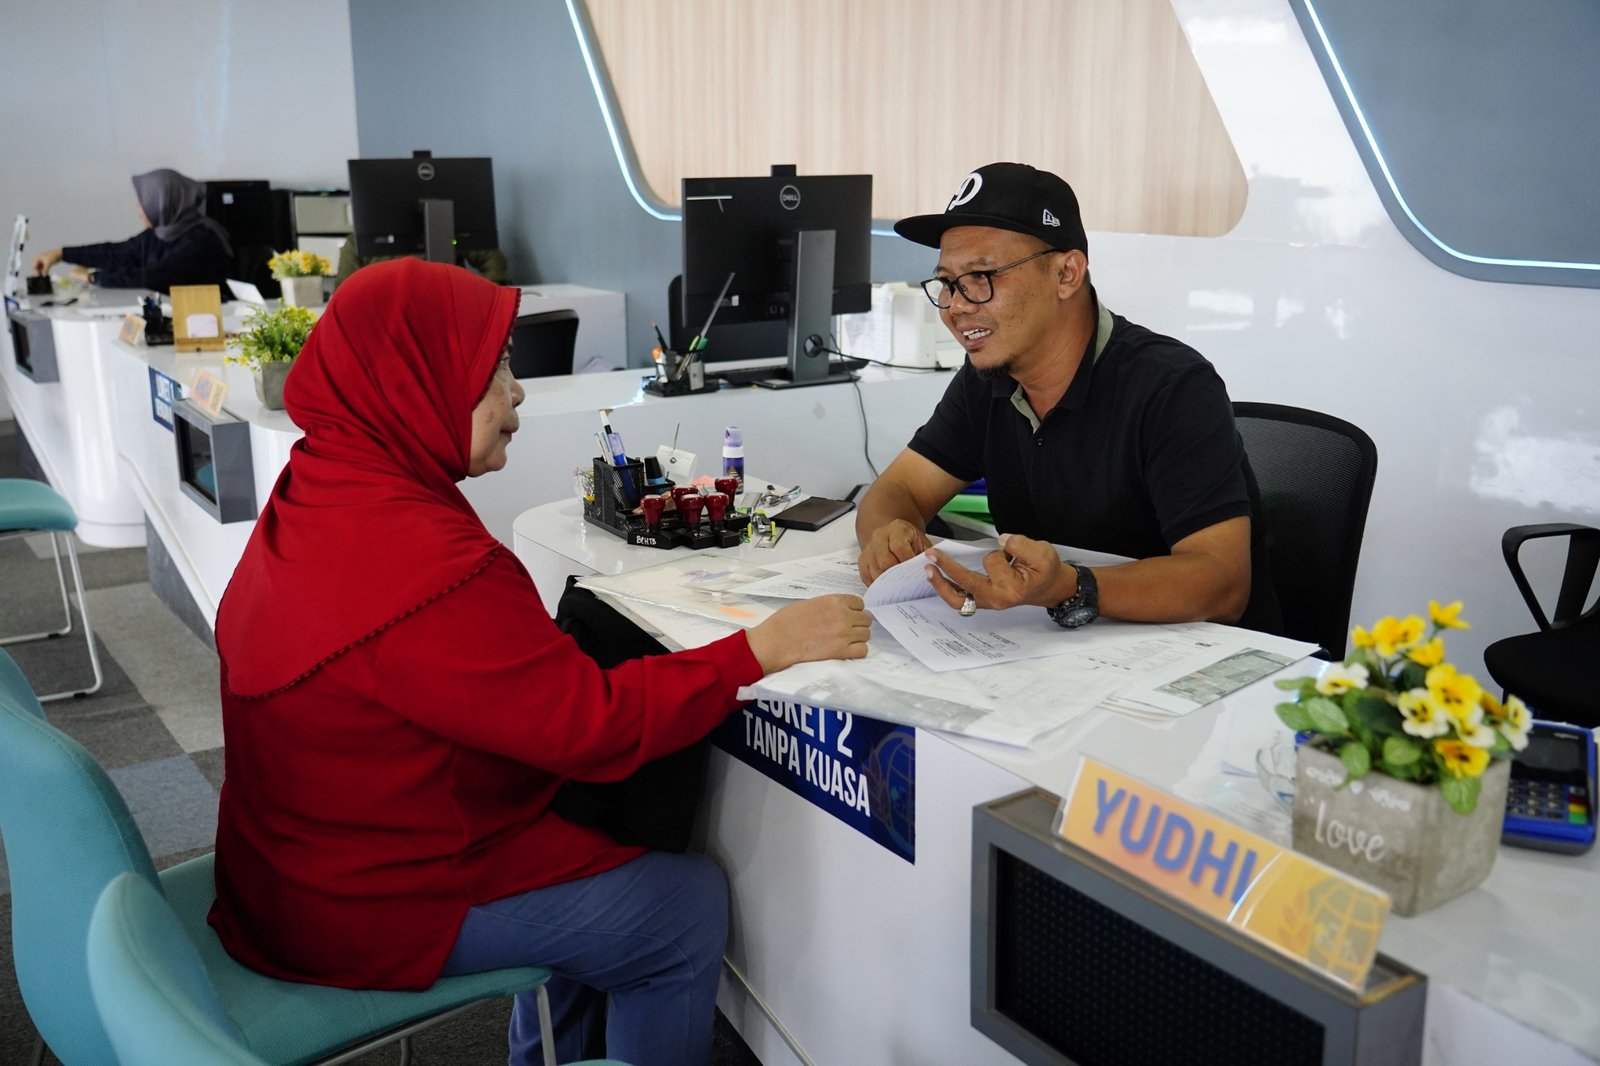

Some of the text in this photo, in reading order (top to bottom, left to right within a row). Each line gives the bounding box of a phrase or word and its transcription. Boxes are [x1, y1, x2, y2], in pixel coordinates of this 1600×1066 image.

[743, 709, 871, 817] TANPA KUASA
[837, 710, 852, 758] 2
[1093, 778, 1257, 905] YUDHI
[1315, 799, 1385, 862] love
